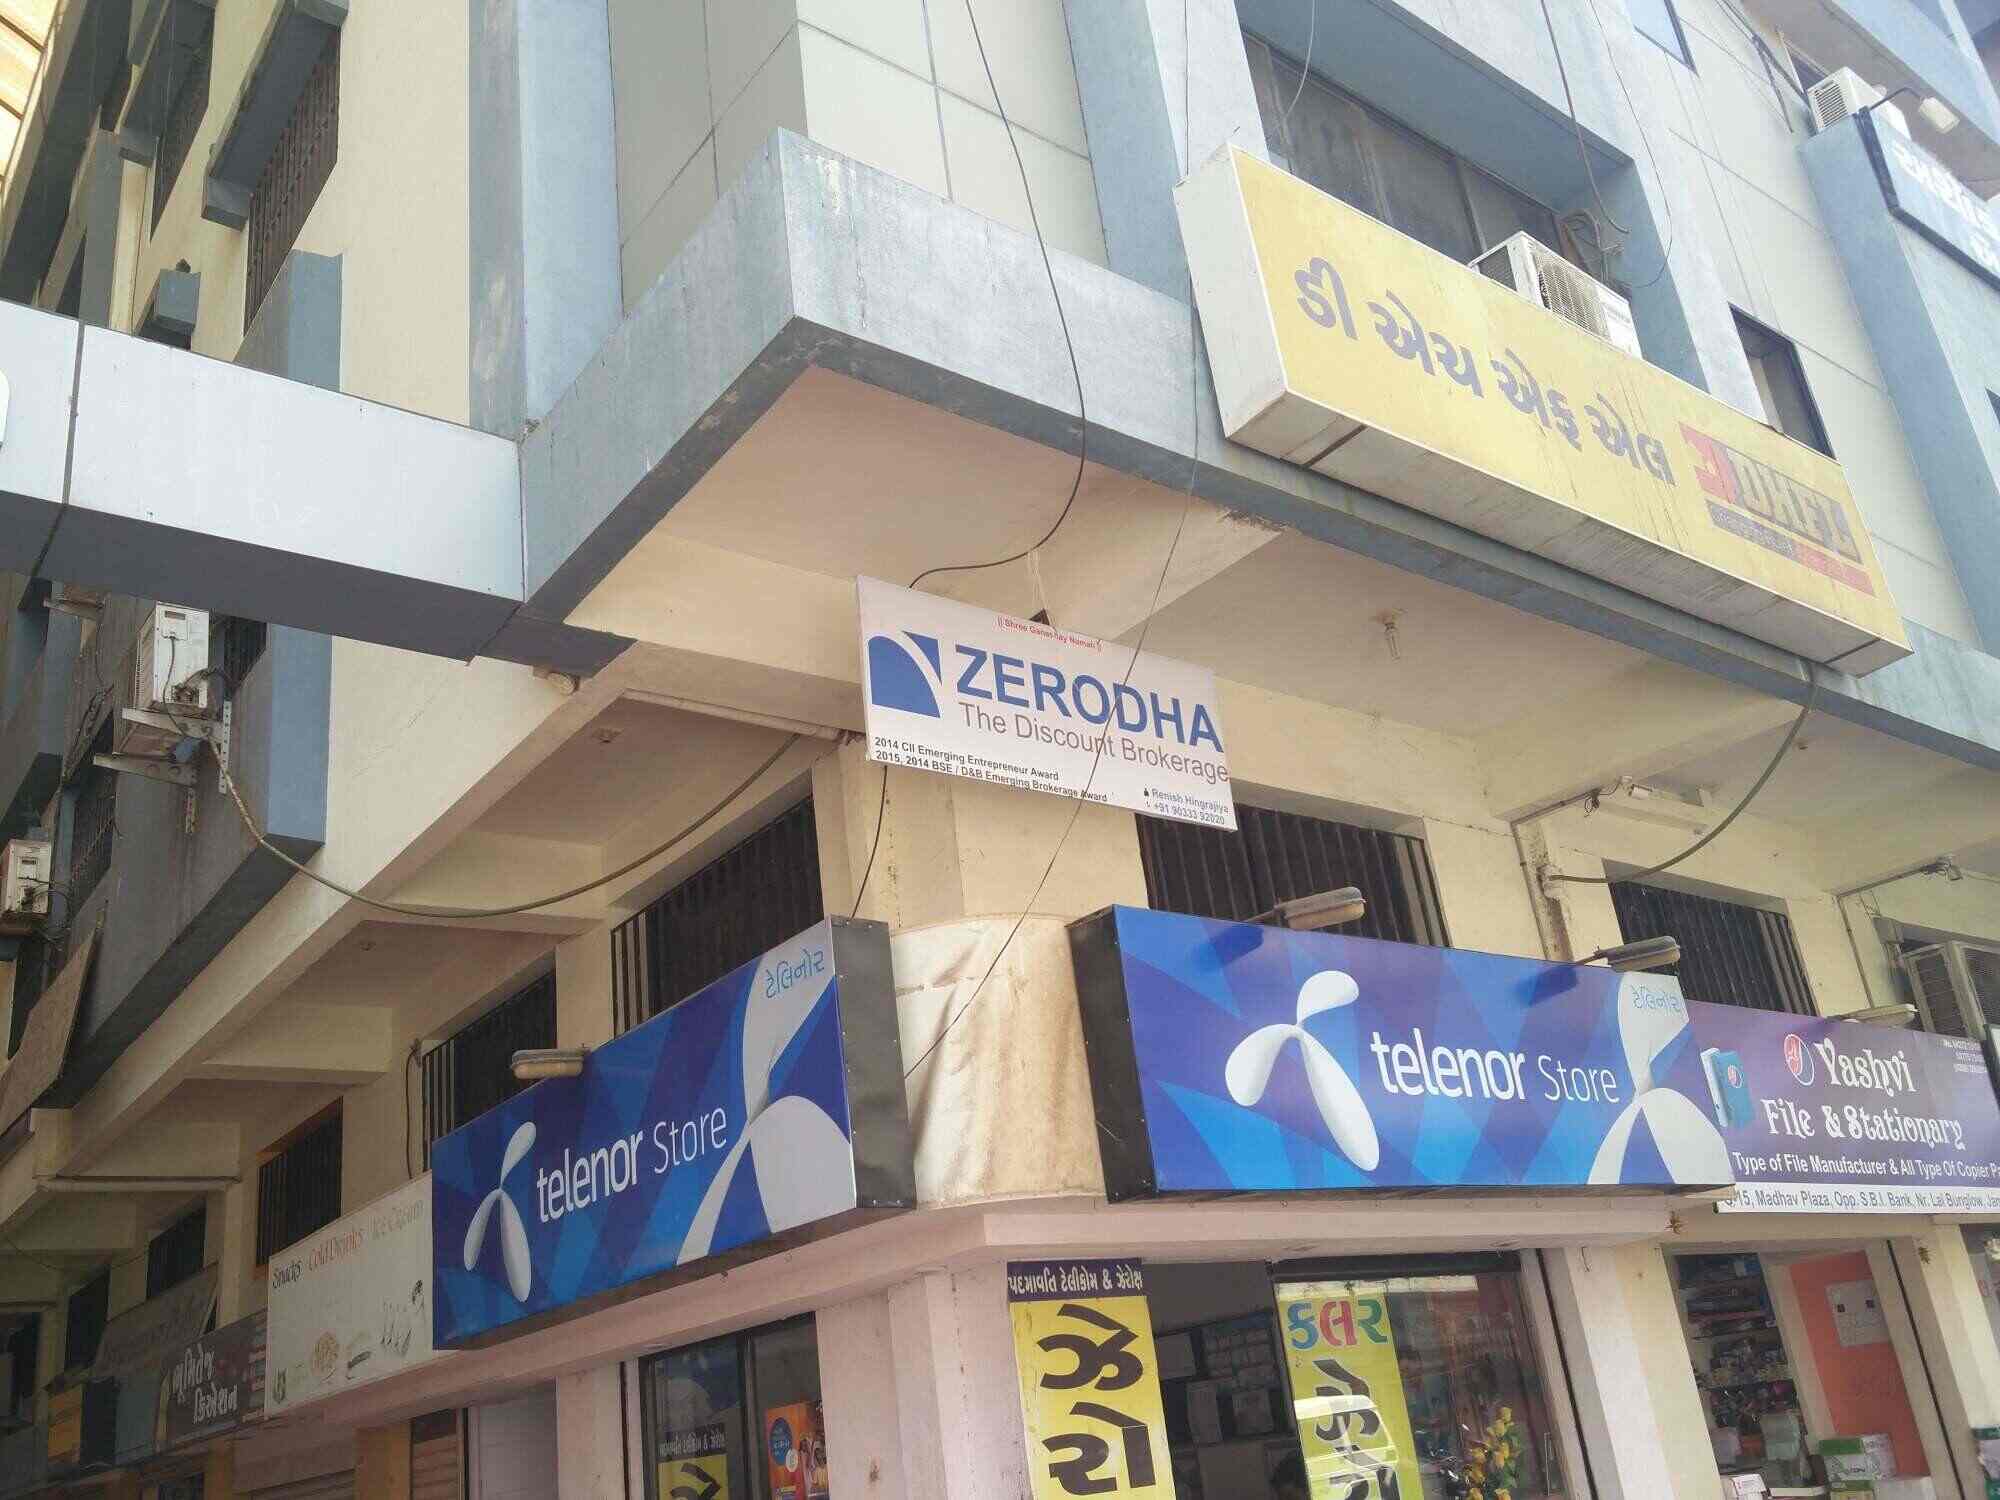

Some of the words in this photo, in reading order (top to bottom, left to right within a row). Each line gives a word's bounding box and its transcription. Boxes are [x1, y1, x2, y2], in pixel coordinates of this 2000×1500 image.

[1294, 257, 1359, 340] ડી
[1490, 348, 1583, 452] એફ
[1585, 392, 1678, 487] એલ
[955, 644, 1224, 753] ZERODHA
[875, 737, 899, 750] 2014
[902, 742, 915, 753] CII
[918, 745, 965, 765] Emerging
[968, 755, 1028, 775] Entrepreneur
[1031, 768, 1059, 781] Award
[906, 755, 929, 768] 2014
[932, 760, 952, 773] BSE
[958, 702, 1007, 733] The
[1016, 714, 1115, 757] Discount
[1121, 738, 1229, 784] Brokerage
[1371, 1028, 1526, 1101] telenor
[1539, 1055, 1620, 1104] Store
[1814, 1038, 1917, 1097] Yashvi
[1763, 1098, 1815, 1139] File
[1822, 1105, 1847, 1138] &
[1843, 1105, 1966, 1150] Stationary
[537, 1131, 644, 1224] telenor
[653, 1107, 727, 1175] Store
[1732, 1152, 1767, 1175] Type
[1770, 1153, 1781, 1172] of
[1784, 1154, 1809, 1172] File
[1809, 1155, 1886, 1175] Manufacturer
[1888, 1159, 1899, 1175] &
[1900, 1159, 1915, 1176] All
[1915, 1159, 1942, 1180] Type
[1756, 1190, 1798, 1207] Madhav
[1102, 1268, 1113, 1290] &
